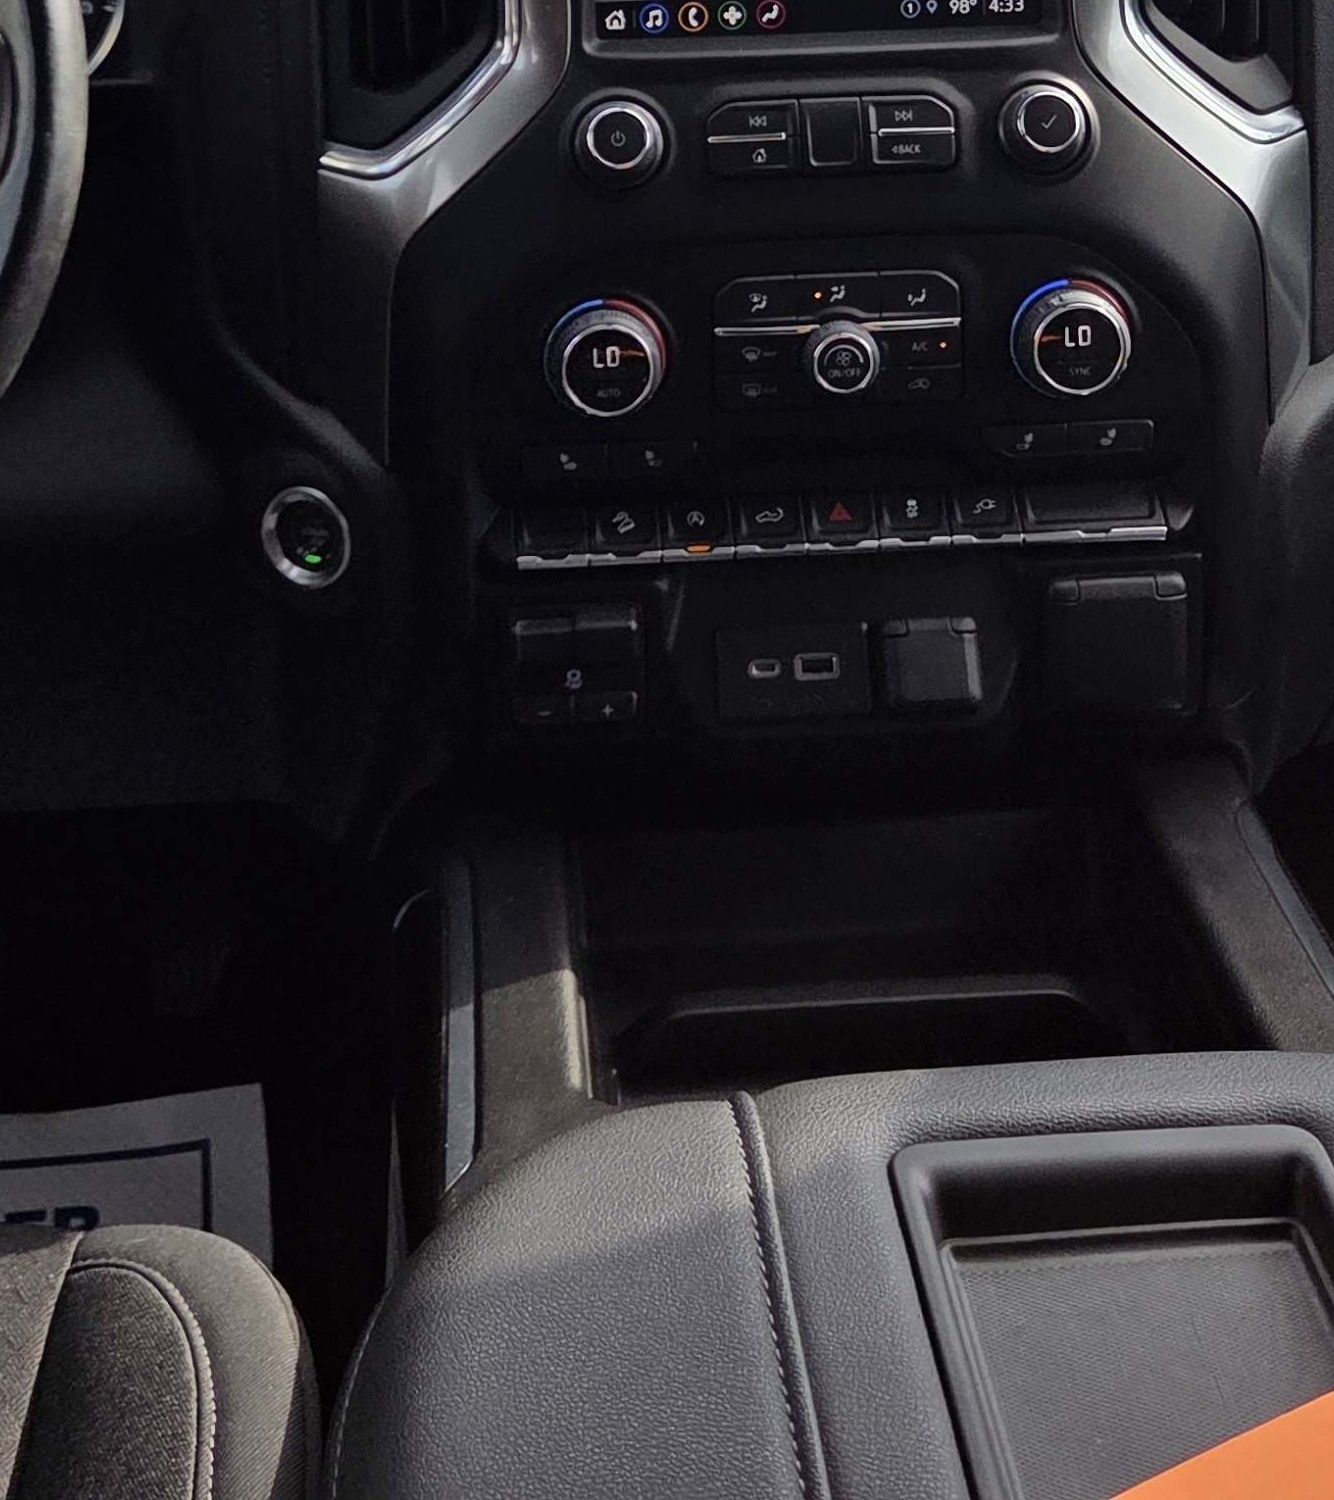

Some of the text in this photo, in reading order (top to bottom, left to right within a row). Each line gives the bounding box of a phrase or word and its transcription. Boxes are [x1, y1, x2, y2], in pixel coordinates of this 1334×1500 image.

[898, 143, 921, 155] BACK
[911, 341, 929, 352] A/C
[827, 368, 862, 379] ON/OFF
